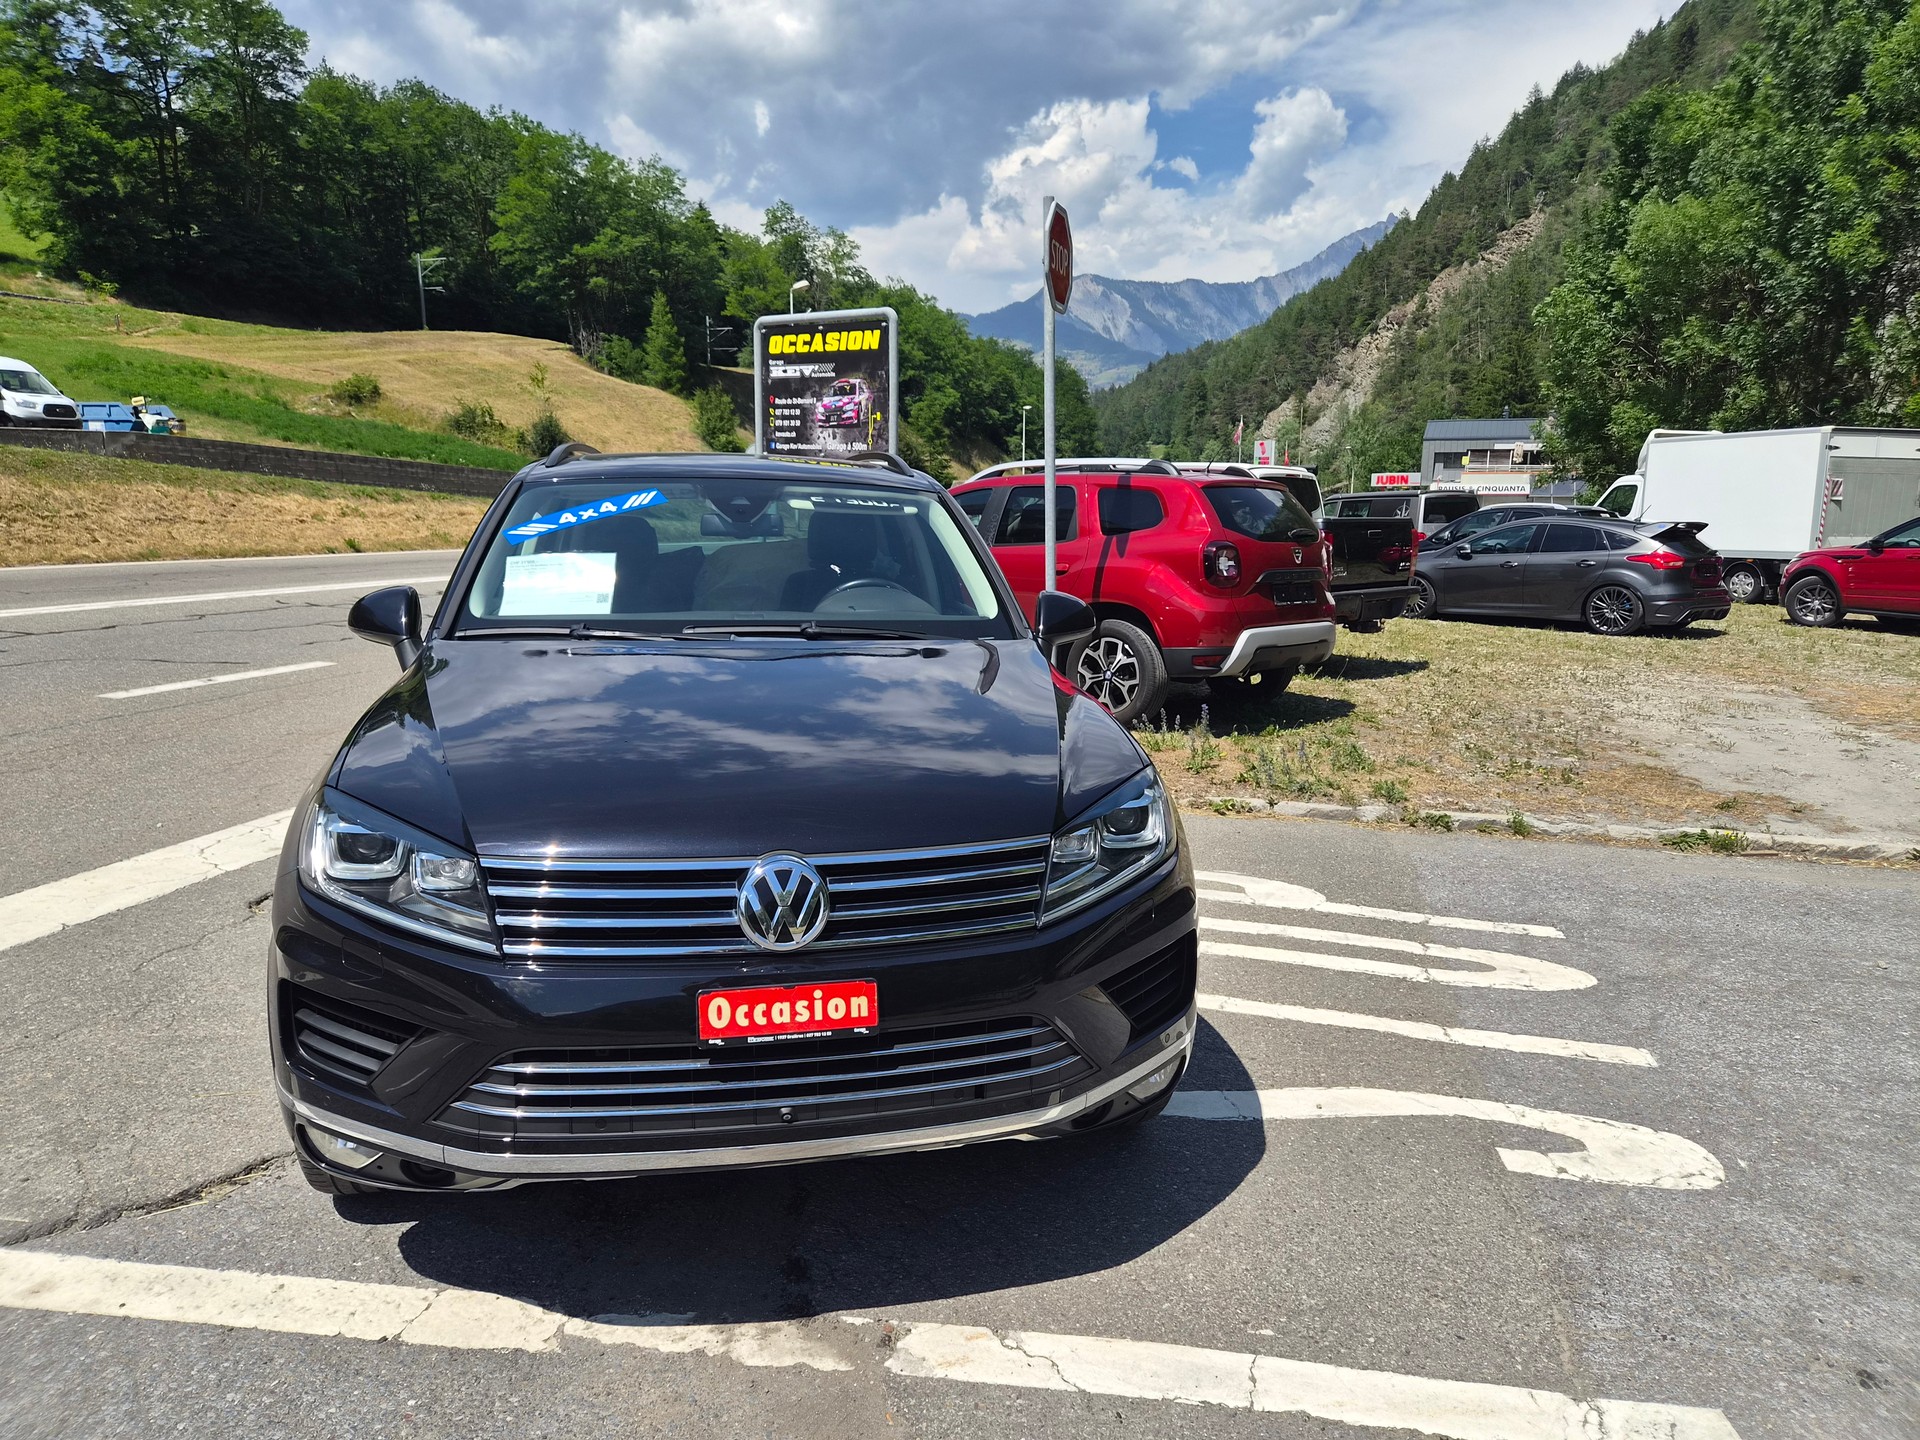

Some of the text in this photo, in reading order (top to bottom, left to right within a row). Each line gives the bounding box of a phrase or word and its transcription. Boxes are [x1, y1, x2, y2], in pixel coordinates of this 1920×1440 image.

[1051, 239, 1069, 277] STOP
[769, 329, 881, 355] OCCASION
[1375, 474, 1409, 486] JUBIN
[707, 989, 869, 1029] Occasion
